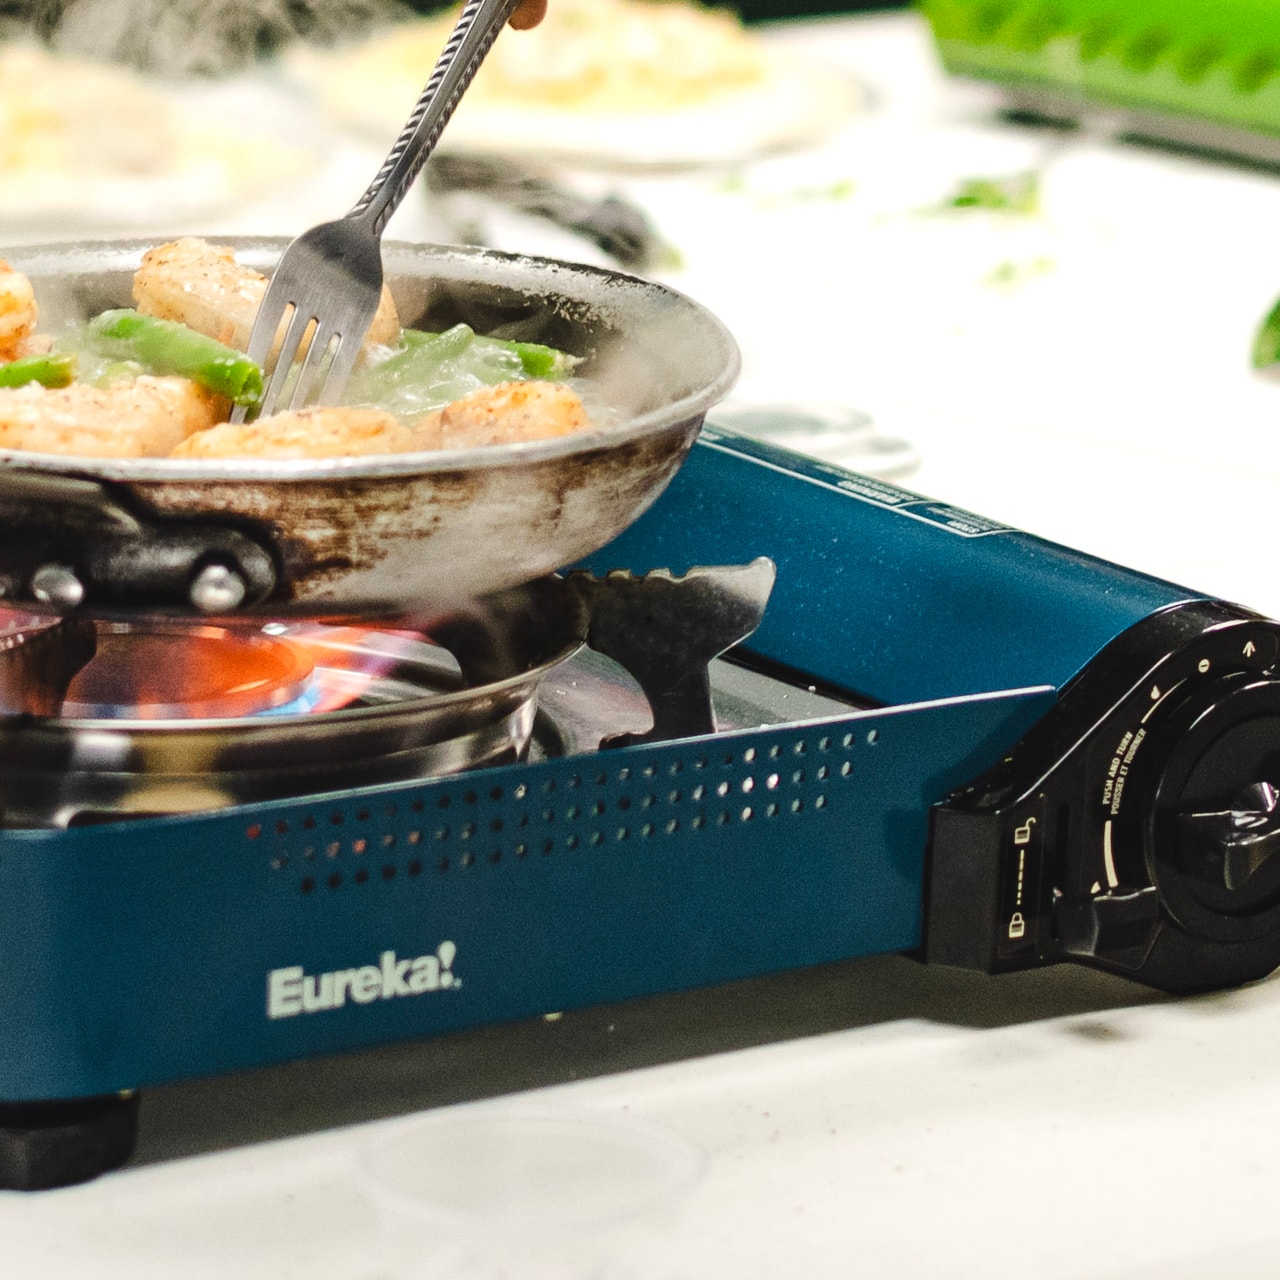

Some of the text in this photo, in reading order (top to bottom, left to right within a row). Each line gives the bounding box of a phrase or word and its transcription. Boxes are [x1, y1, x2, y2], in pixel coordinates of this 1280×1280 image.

[1102, 731, 1133, 805] PUSH AND TURN
[1111, 728, 1147, 815] POUSSER ET TOURNER
